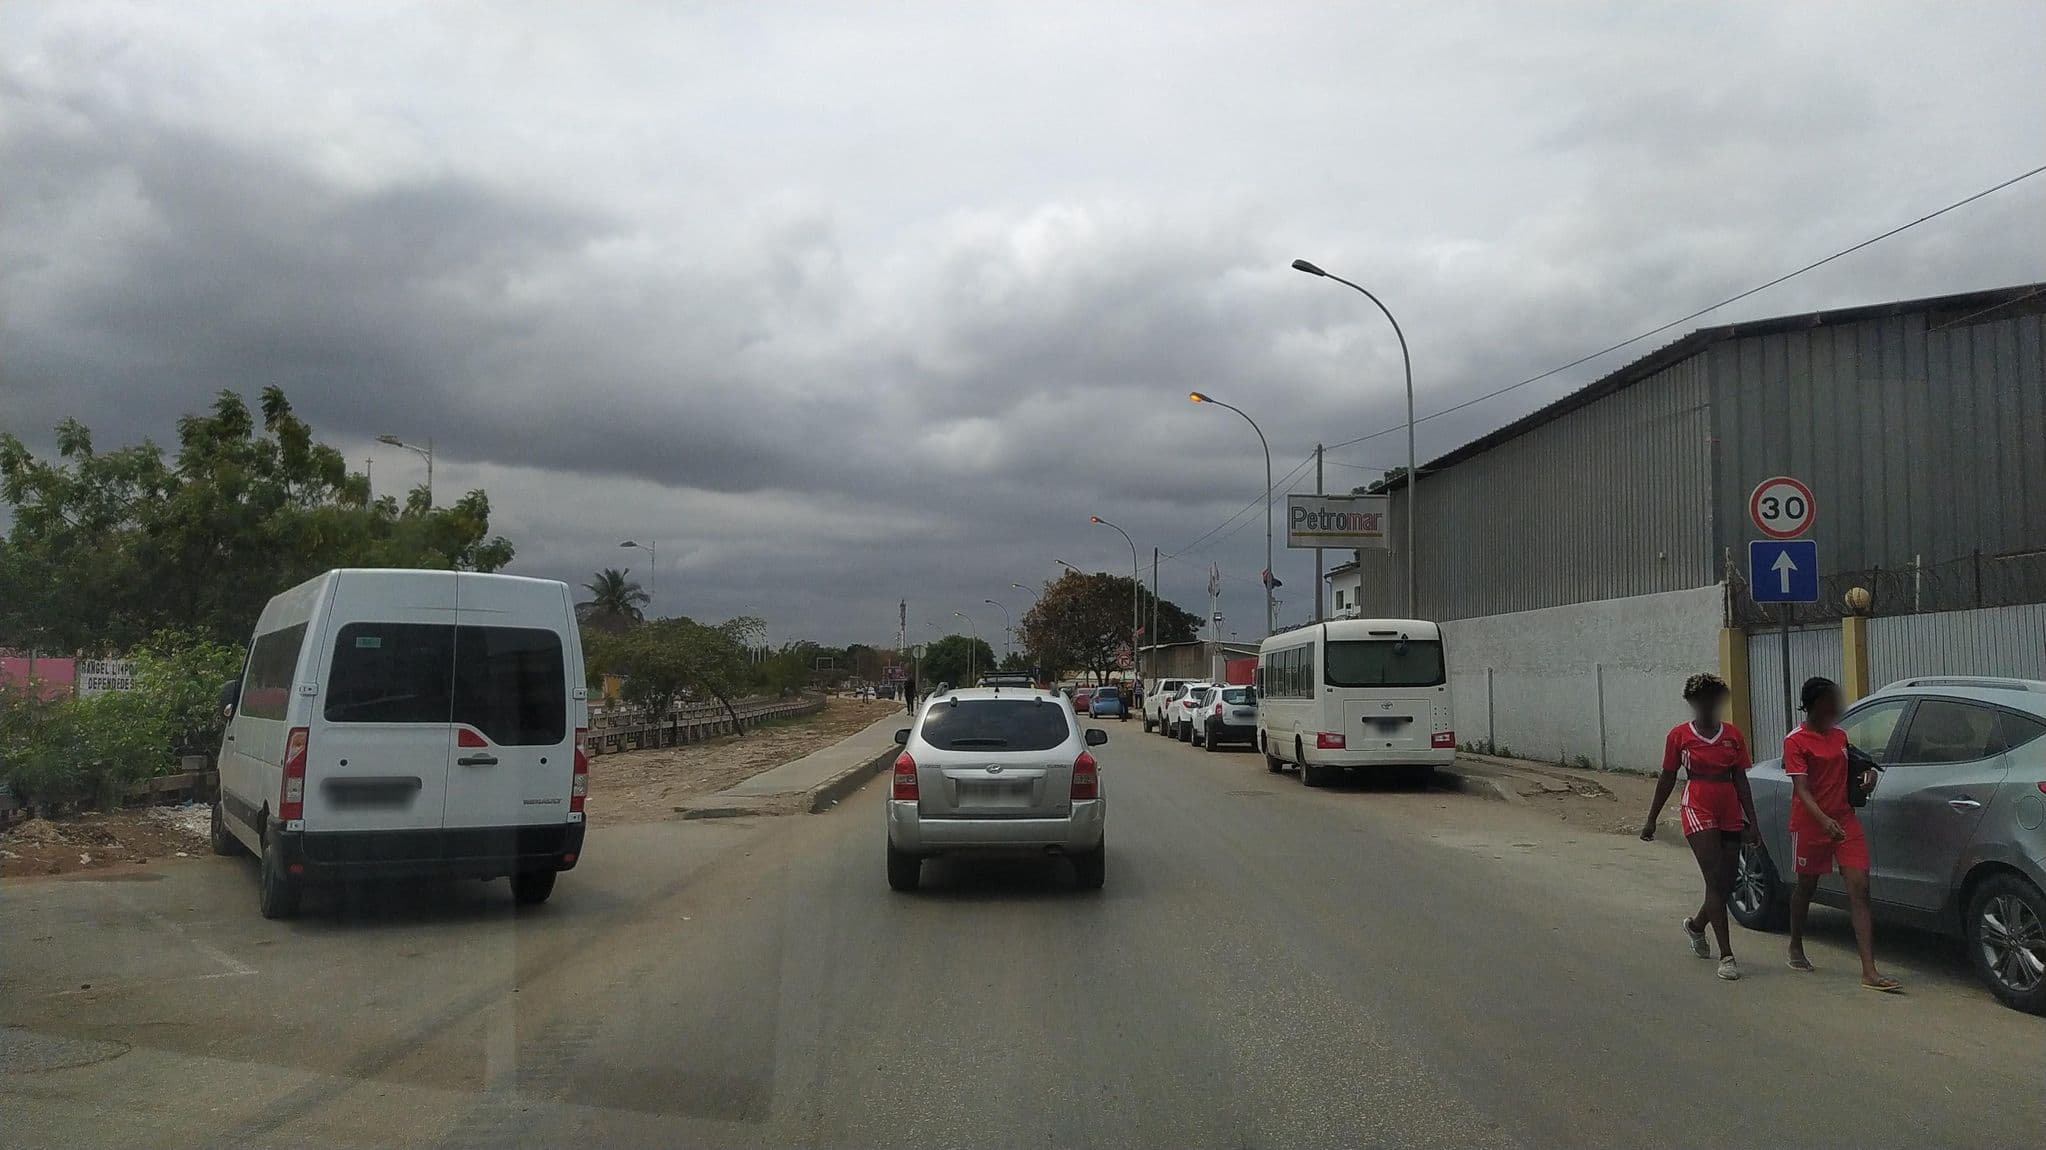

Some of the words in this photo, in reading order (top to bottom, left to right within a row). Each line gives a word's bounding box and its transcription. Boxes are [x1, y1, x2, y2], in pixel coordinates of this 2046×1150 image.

[1291, 506, 1383, 531] Petromar
[1761, 497, 1805, 520] 30
[81, 661, 110, 675] RANGEL
